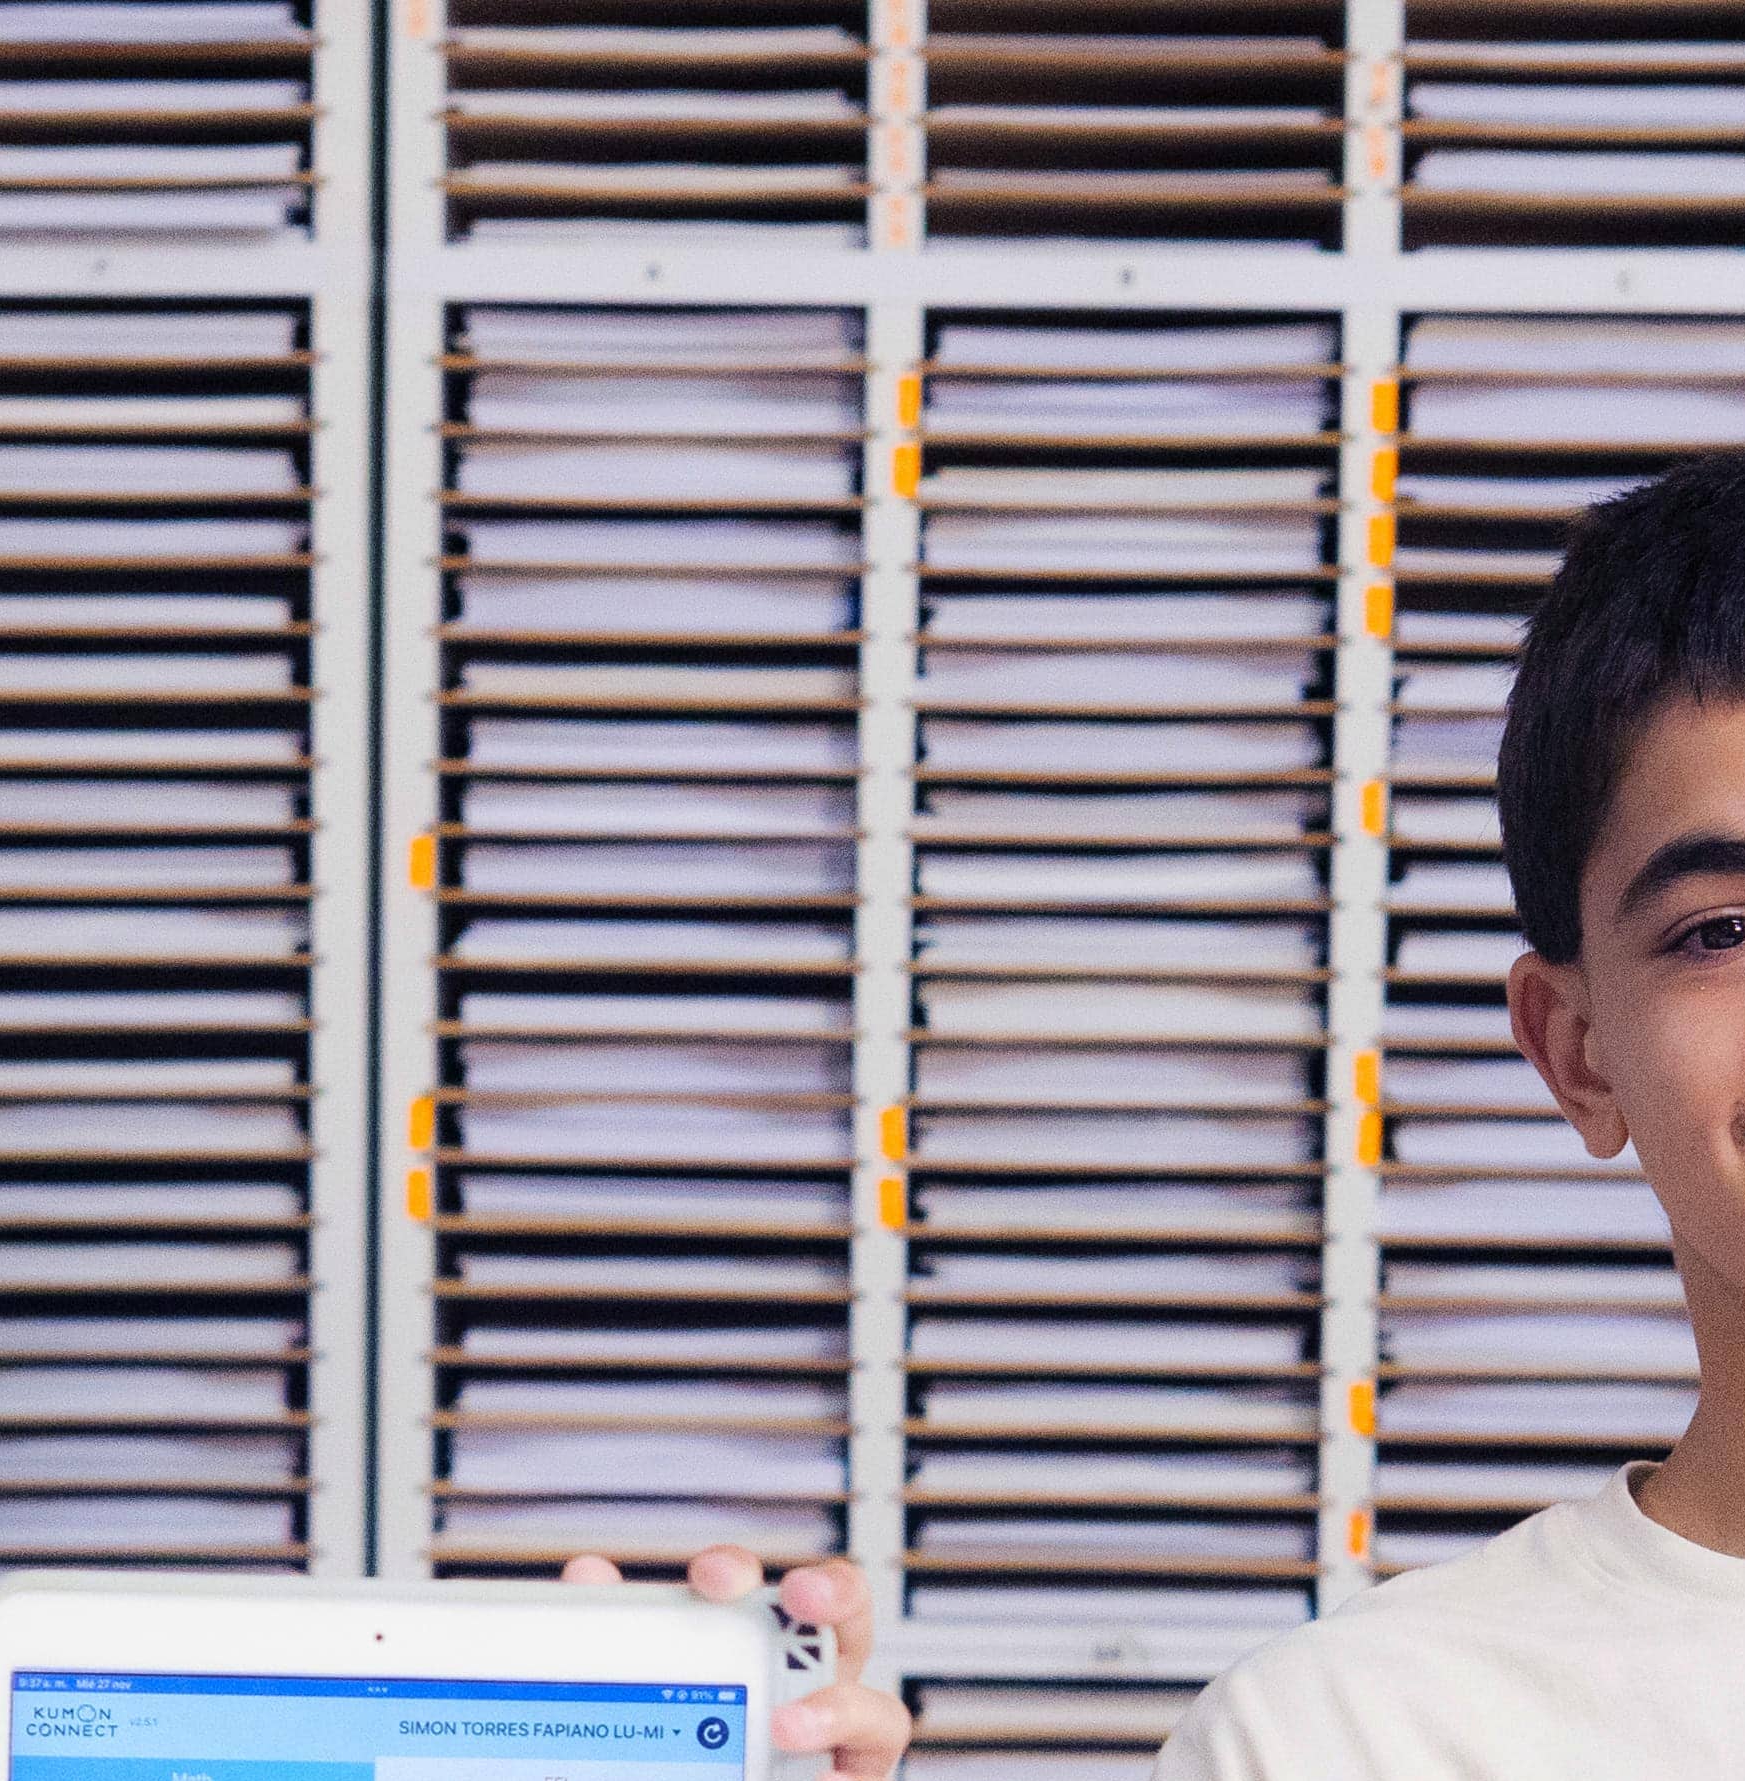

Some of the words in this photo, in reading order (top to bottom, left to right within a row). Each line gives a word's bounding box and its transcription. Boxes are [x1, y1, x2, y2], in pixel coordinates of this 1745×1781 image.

[33, 1704, 112, 1723] KUMON
[26, 1722, 118, 1738] CONNECT
[398, 1720, 456, 1736] SIMON
[461, 1721, 528, 1737] TORRES
[533, 1723, 608, 1739] FAPIANO
[614, 1724, 664, 1740] LU-MI
